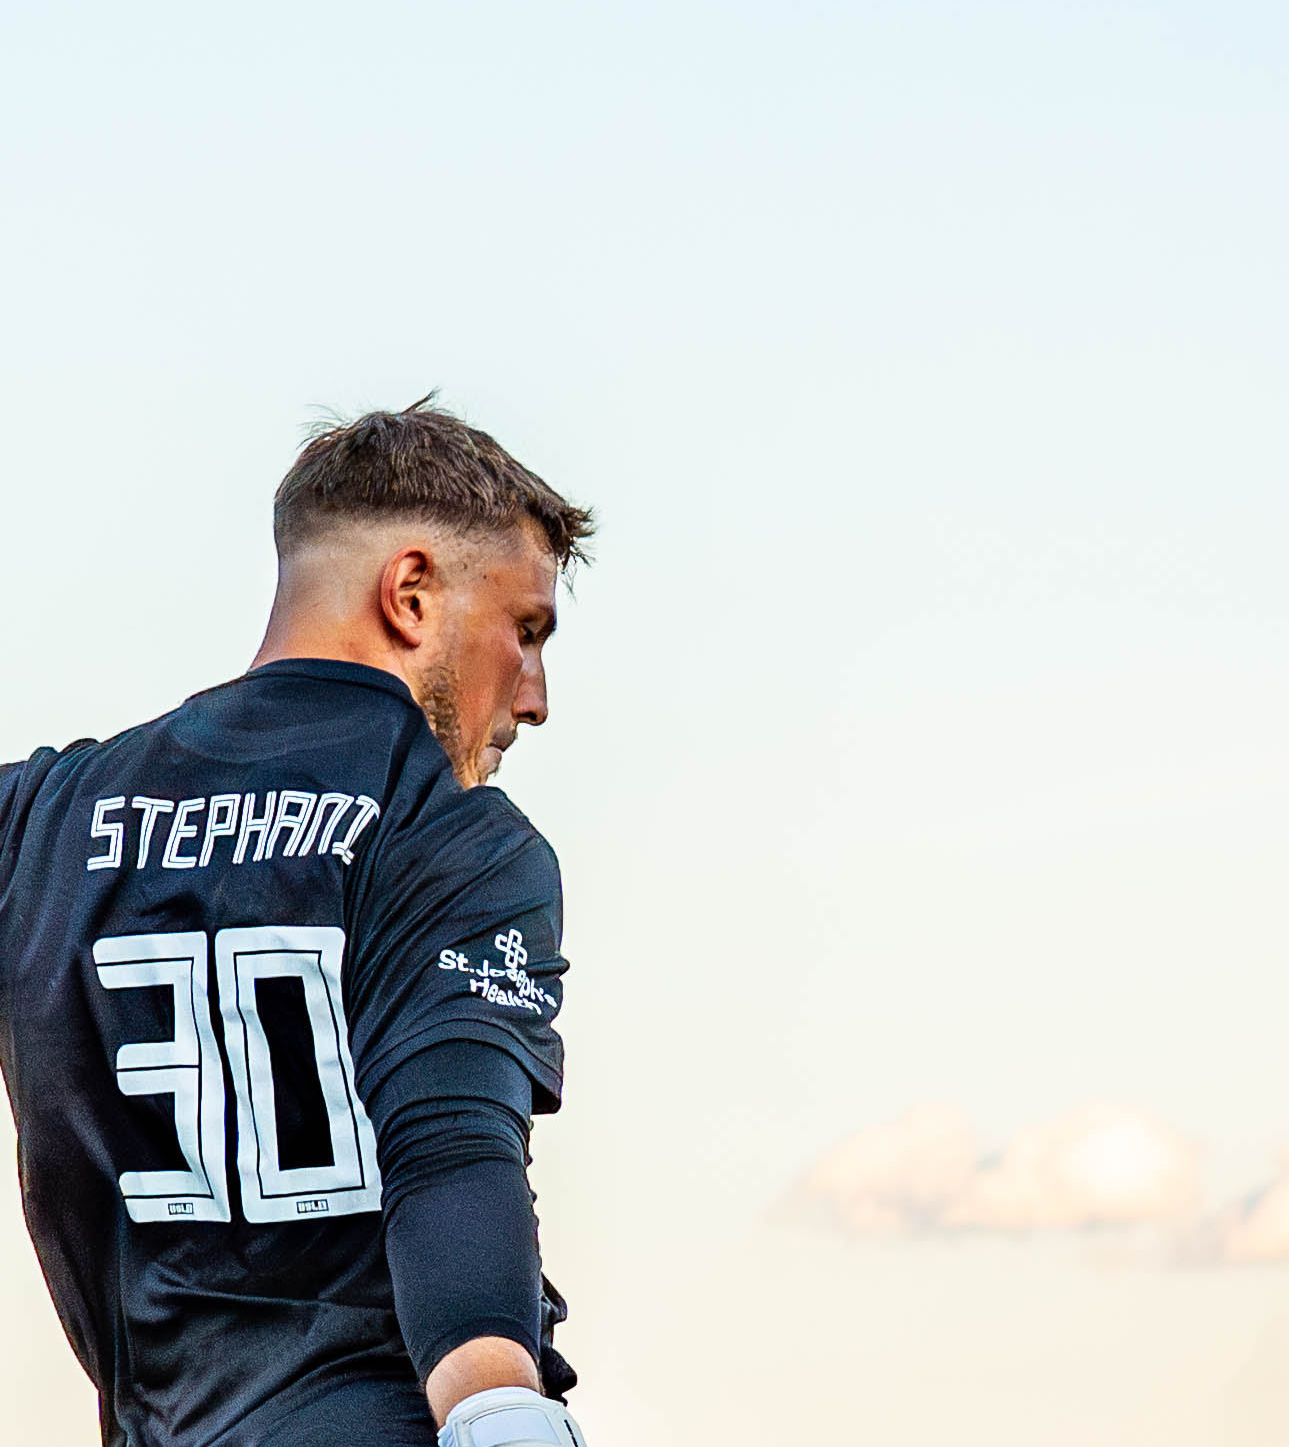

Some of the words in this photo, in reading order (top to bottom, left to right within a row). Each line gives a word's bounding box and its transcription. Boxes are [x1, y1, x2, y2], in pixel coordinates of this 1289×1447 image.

[438, 949, 475, 973] St.
[469, 978, 542, 1016] Health
[92, 925, 384, 1224] 30
